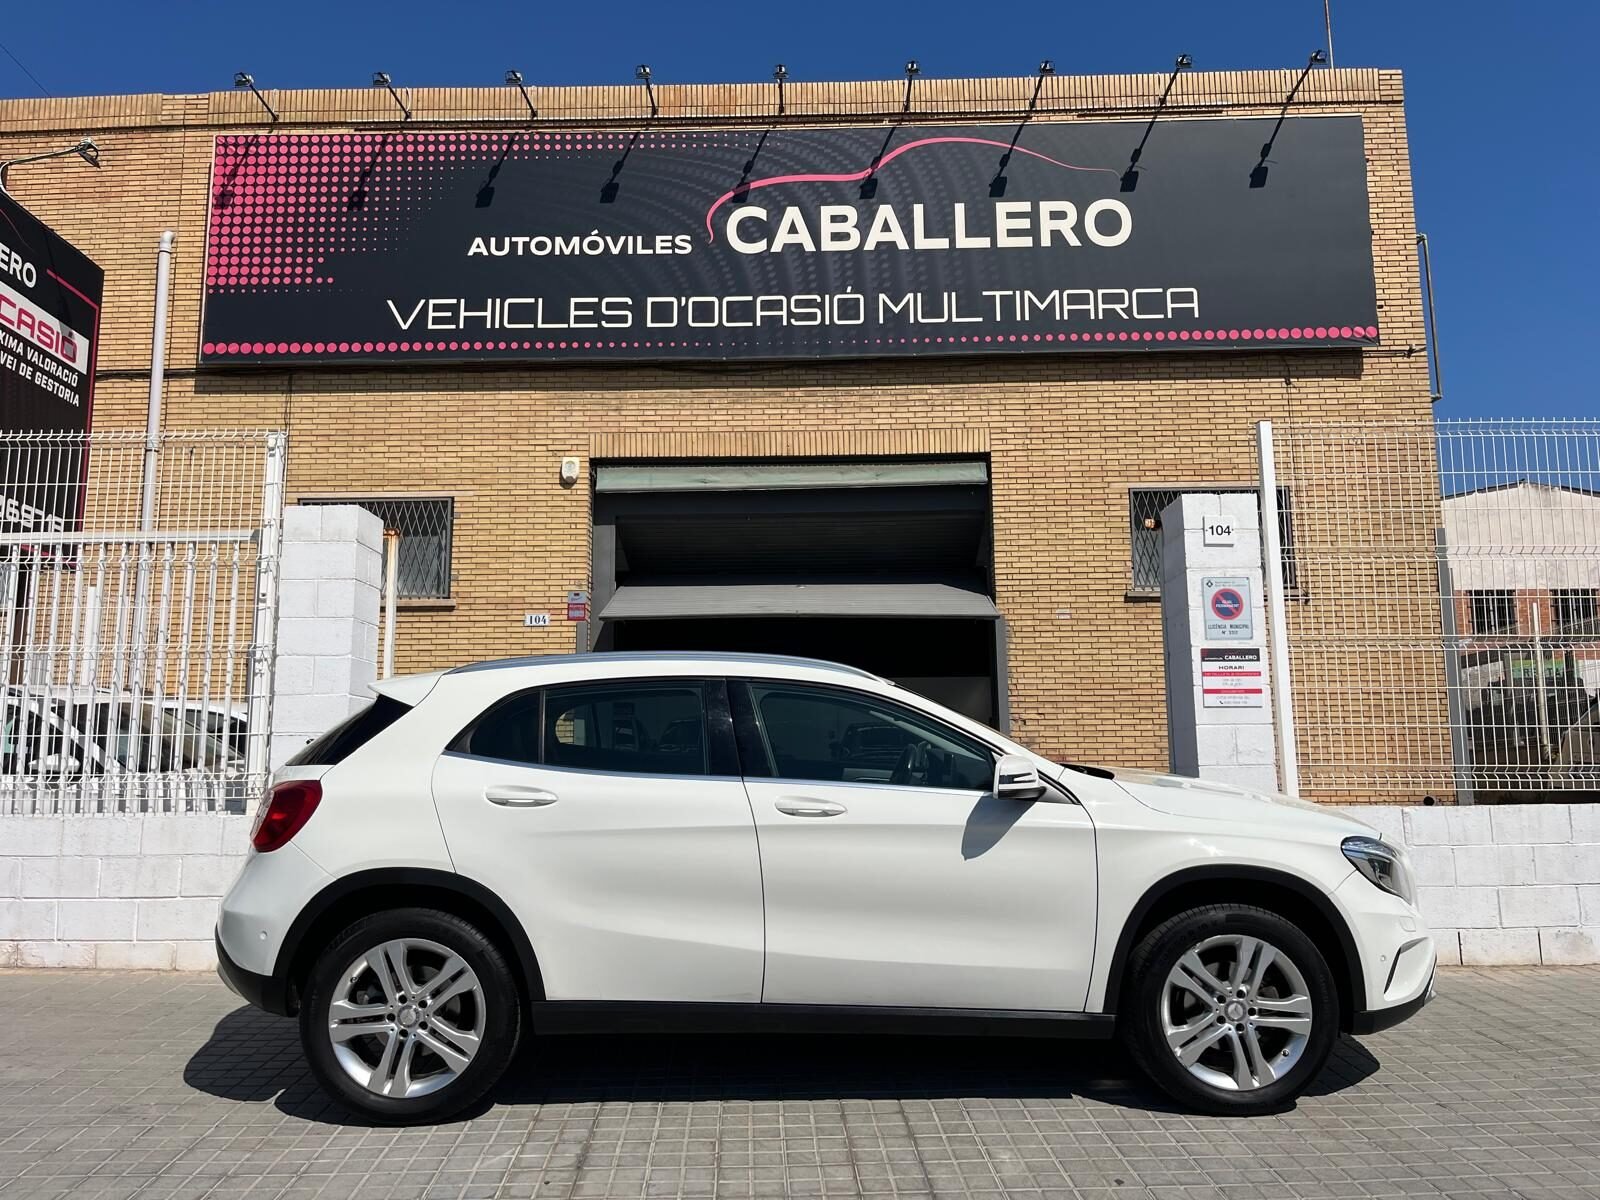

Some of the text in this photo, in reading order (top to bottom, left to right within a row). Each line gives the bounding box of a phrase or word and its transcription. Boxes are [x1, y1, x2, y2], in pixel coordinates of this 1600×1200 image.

[467, 198, 1133, 256] AUTOMÓVILES CABALLERO
[0, 293, 78, 363] CASIÓ
[386, 286, 1200, 330] VEHICLES D'OCASIÓ MULTIMARCA
[18, 362, 33, 380] DE
[34, 371, 79, 407] GESTORIA
[27, 346, 79, 387] VALORACIÓ
[1208, 525, 1232, 536] 104
[529, 615, 546, 625] 104
